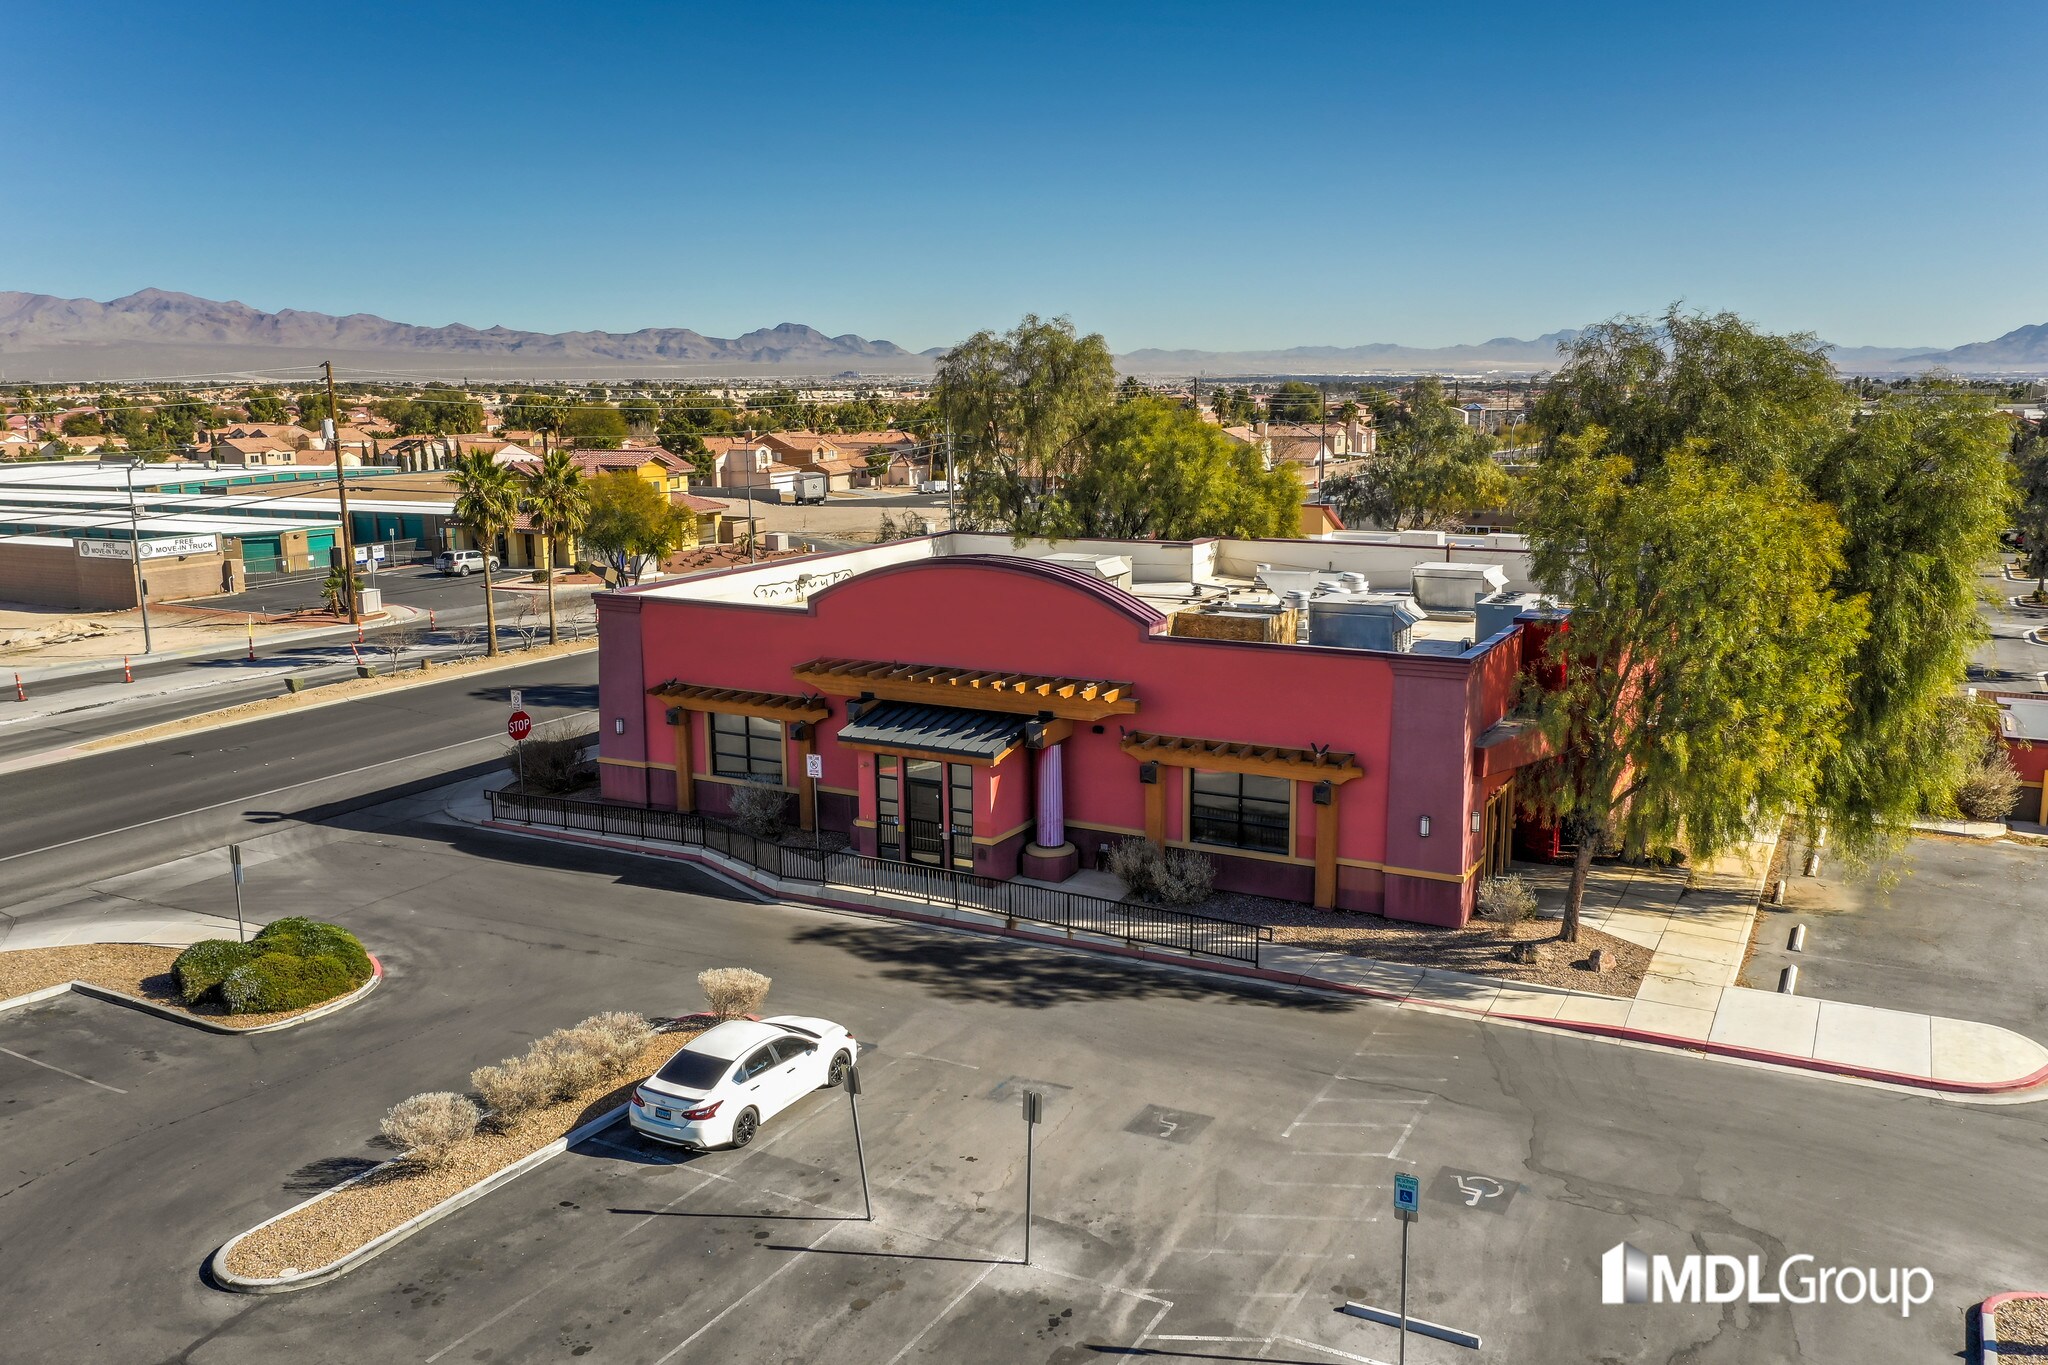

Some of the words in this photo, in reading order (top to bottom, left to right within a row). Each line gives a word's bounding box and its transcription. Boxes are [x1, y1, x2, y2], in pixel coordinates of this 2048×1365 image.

[156, 545, 187, 553] MOVE-IN
[189, 542, 213, 550] TRUCK
[509, 719, 530, 733] STOP
